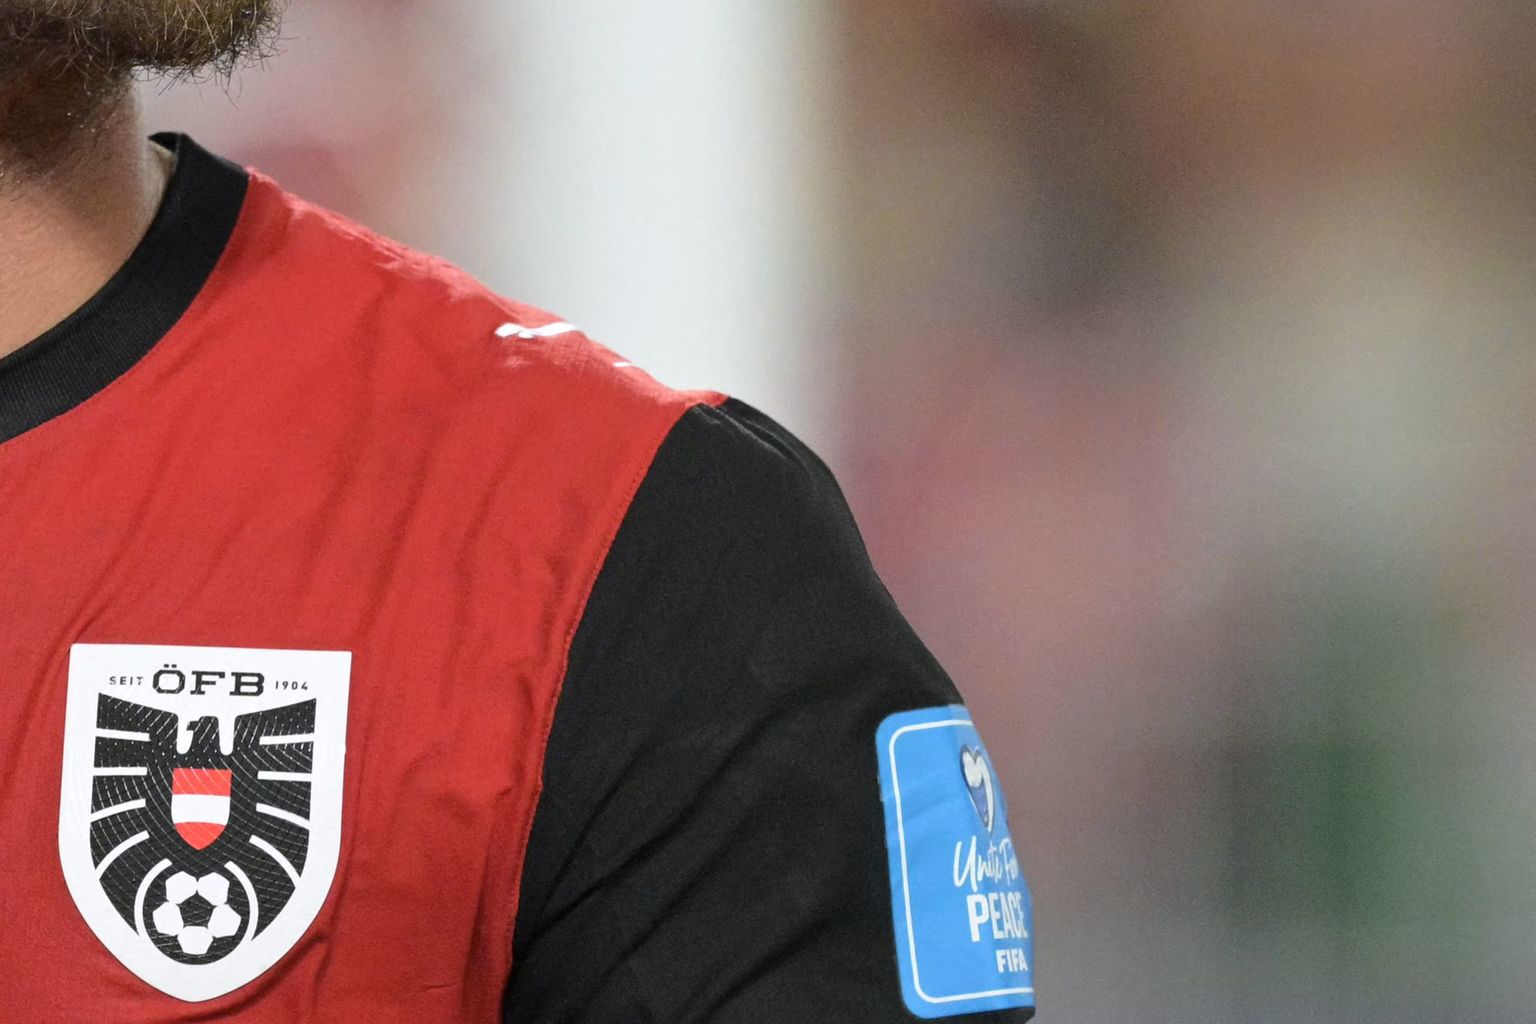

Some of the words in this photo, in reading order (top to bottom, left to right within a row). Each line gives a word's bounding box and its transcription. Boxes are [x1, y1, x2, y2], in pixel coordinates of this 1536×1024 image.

[109, 676, 144, 686] SEIT
[152, 663, 265, 696] ÖFB
[275, 680, 308, 691] 1904
[966, 892, 1028, 942] PEACE
[996, 948, 1028, 973] FIFA
